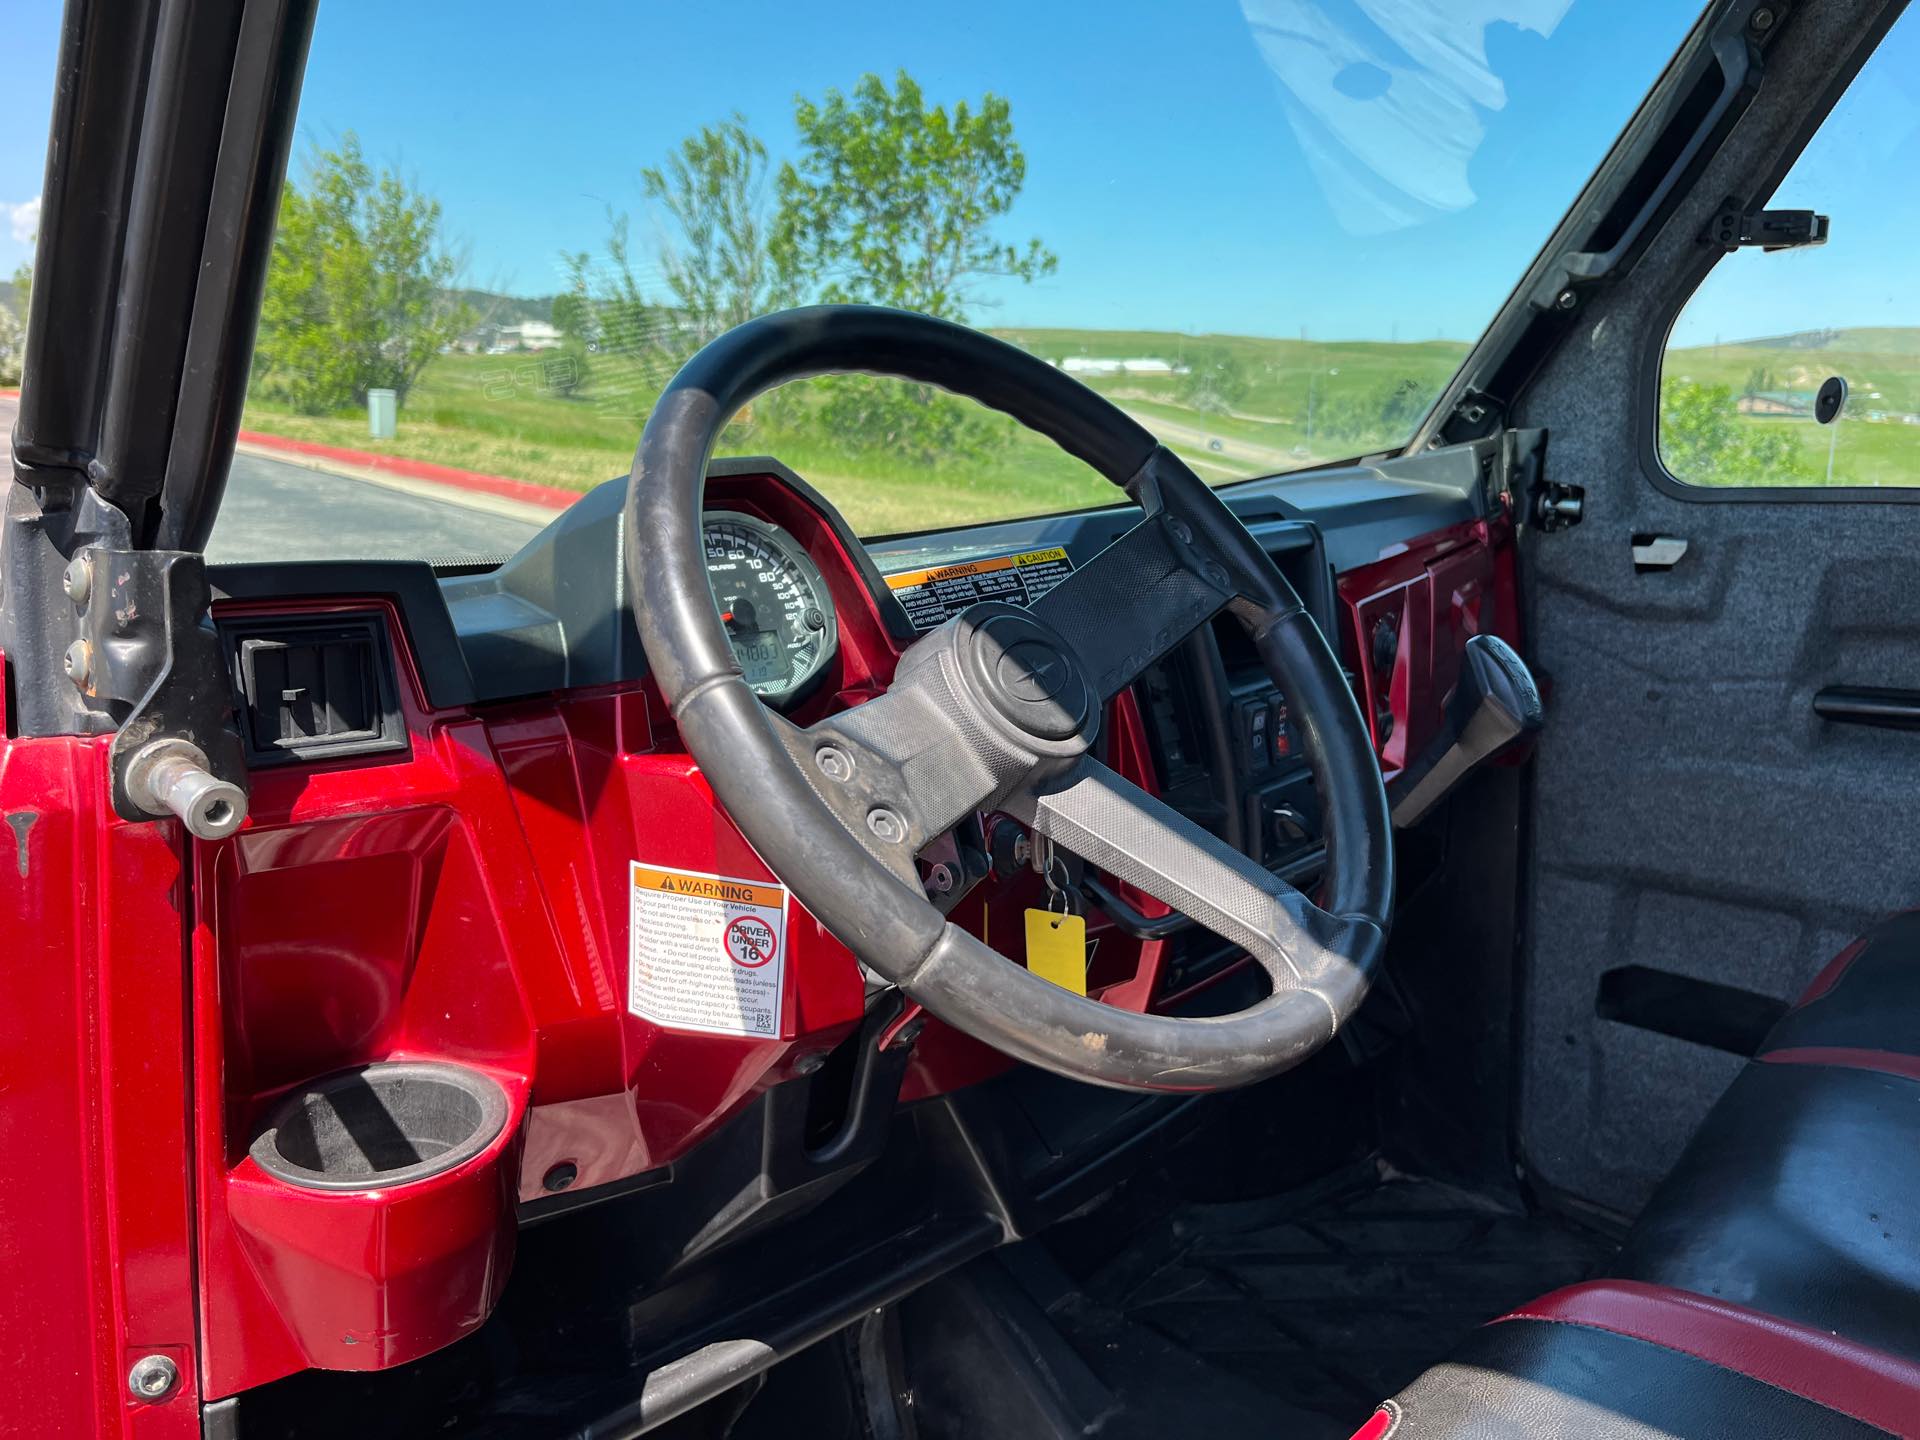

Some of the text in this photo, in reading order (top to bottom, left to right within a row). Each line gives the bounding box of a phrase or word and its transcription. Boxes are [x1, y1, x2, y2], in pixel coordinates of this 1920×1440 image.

[708, 548, 724, 557] 50
[728, 550, 745, 560] 60
[1026, 549, 1061, 564] CAUTION
[746, 559, 762, 569] 70
[759, 573, 775, 582] 80
[934, 565, 977, 579] WARNING
[678, 879, 753, 901] WARNING
[636, 888, 661, 899] Require
[662, 893, 686, 904] Proper
[713, 900, 729, 909] Your
[730, 903, 756, 914] Vehicle
[643, 900, 656, 908] your
[658, 902, 670, 910] part
[679, 905, 703, 916] prevent
[640, 906, 647, 915] Do
[660, 911, 675, 919] allow
[676, 913, 703, 924] careless
[640, 917, 663, 927] reckless
[639, 925, 653, 934] Make
[669, 931, 699, 943] operators
[731, 924, 771, 938] DRIVER
[679, 941, 694, 950] valid
[695, 944, 718, 954] driver's
[731, 935, 769, 948] UNDER
[698, 954, 720, 964] people
[740, 946, 760, 960] 16
[658, 957, 670, 965] ride
[671, 958, 685, 967] after
[687, 962, 704, 971] using
[706, 964, 728, 973] alcohol
[655, 966, 670, 974] allow
[672, 968, 702, 980] operation
[713, 974, 732, 984] public
[734, 976, 752, 985] roads
[753, 978, 776, 990] (unless
[705, 991, 724, 1000] trucks
[718, 984, 740, 993] vehicle
[741, 985, 766, 998] access)
[654, 992, 675, 1002] exceed
[677, 996, 700, 1007] seating
[658, 1002, 677, 1011] public
[679, 1006, 696, 1014] roads
[698, 1009, 711, 1017] may
[722, 1010, 756, 1022] hazardous
[671, 1013, 698, 1023] violation
